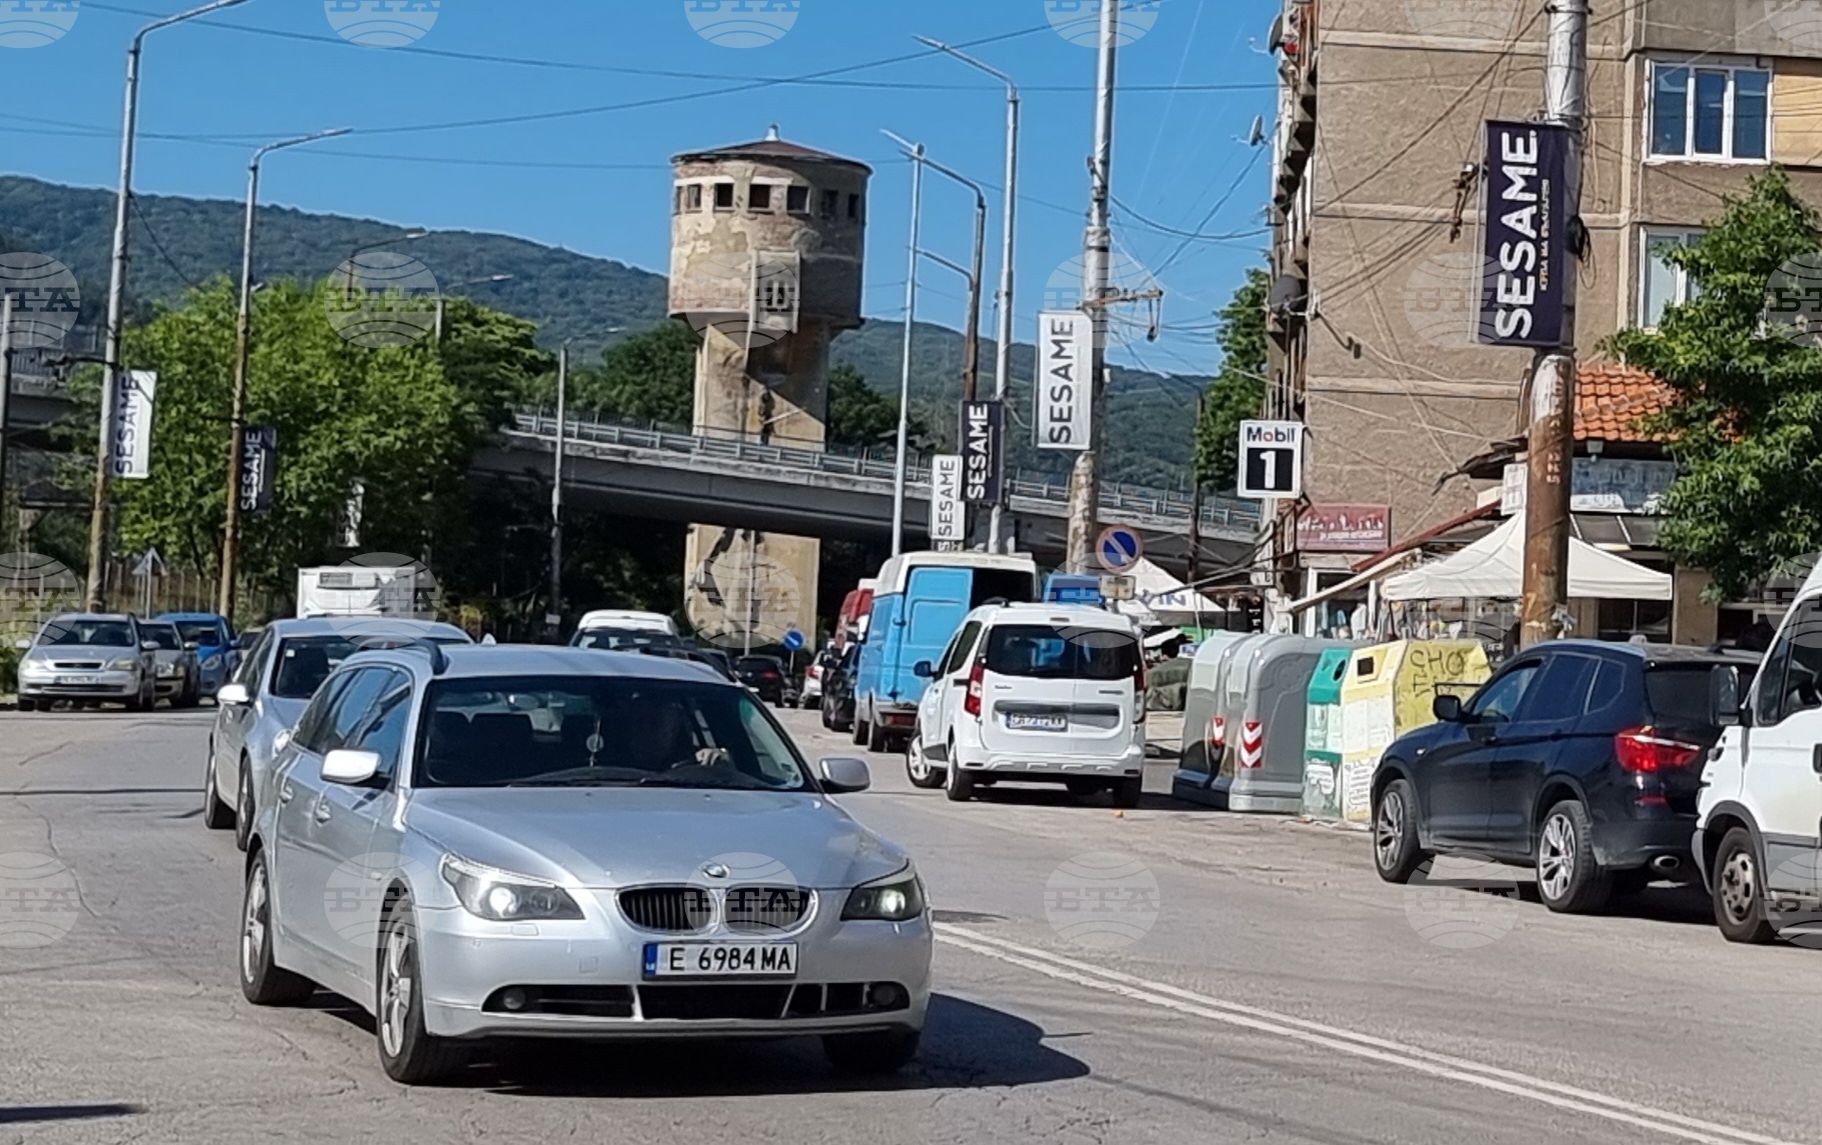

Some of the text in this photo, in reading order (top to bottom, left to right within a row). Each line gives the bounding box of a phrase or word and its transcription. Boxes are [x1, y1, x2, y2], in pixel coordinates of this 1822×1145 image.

[1495, 131, 1538, 339] SESAME
[1048, 318, 1074, 444] SESAME
[116, 376, 138, 474] SESAME
[967, 403, 988, 500] SESAME
[1247, 426, 1296, 443] Mobil
[241, 430, 262, 510] SESAME
[938, 459, 955, 538] SESAME
[1259, 450, 1276, 489] 1
[669, 946, 792, 972] E 6984 MA
